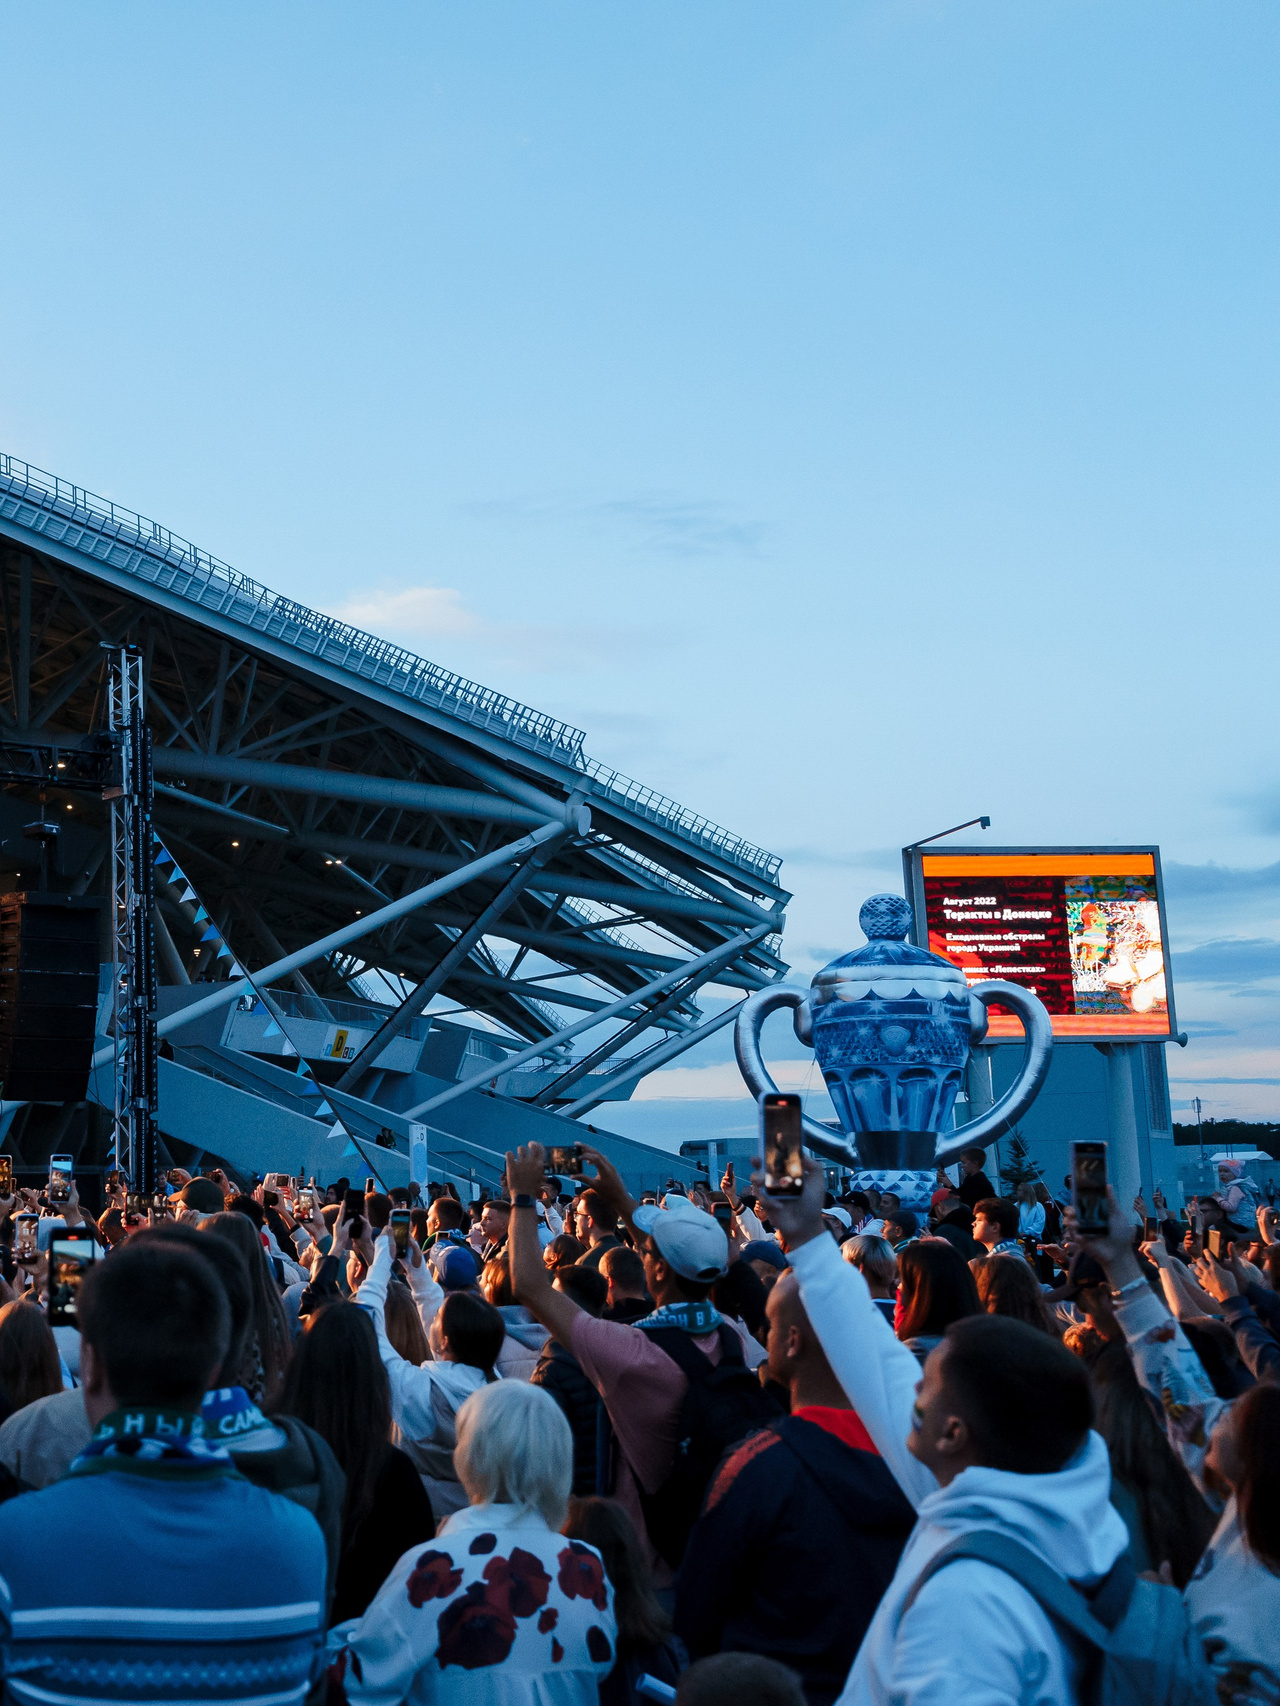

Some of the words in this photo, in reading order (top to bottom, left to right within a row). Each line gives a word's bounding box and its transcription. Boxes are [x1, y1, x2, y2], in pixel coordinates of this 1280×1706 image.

[943, 897, 973, 907] Август
[974, 897, 997, 905] 2022
[943, 909, 993, 921] Теракты
[1002, 909, 1053, 920] Донецке
[945, 933, 1002, 941] Ежедневные
[1003, 932, 1045, 942] обстрелы
[946, 945, 977, 953] города
